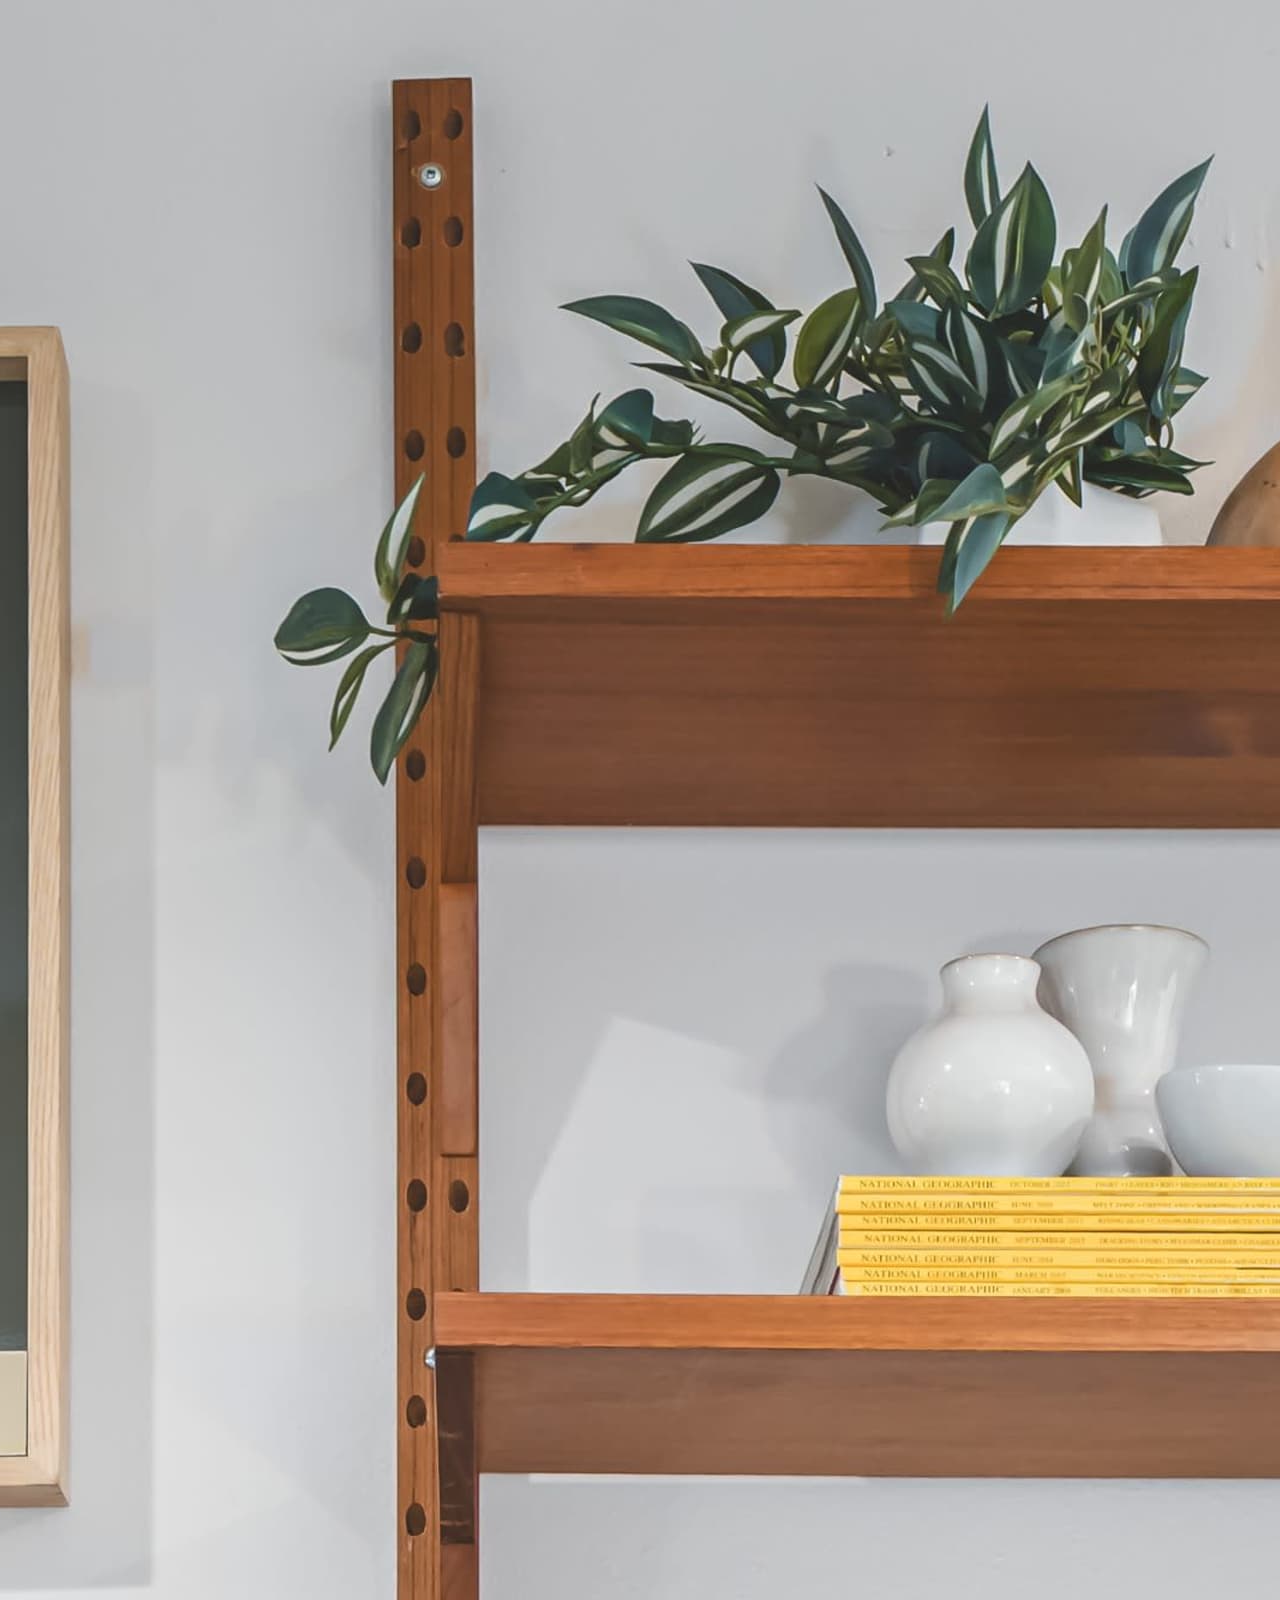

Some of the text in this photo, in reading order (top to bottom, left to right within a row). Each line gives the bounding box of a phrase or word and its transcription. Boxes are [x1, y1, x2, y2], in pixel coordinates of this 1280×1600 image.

[860, 1180, 917, 1189] NATIONAL
[922, 1180, 995, 1189] GEOGRAPHIC
[860, 1200, 918, 1209] NATIONAL
[924, 1200, 999, 1209] GEOGRAPHIC
[862, 1216, 920, 1225] NATIONAL
[925, 1216, 997, 1225] GEOGRAPHIC
[864, 1234, 922, 1244] NATIONAL
[927, 1234, 1001, 1244] GEOGRAPHIC
[861, 1254, 919, 1263] NATIONAL
[925, 1254, 1000, 1263] GEOGRAPHIC
[864, 1270, 922, 1279] NATIONAL
[927, 1270, 1001, 1279] GEOGRAPHIC
[862, 1285, 919, 1293] NATIONAL
[925, 1285, 1004, 1294] GEOGRAPHIC
